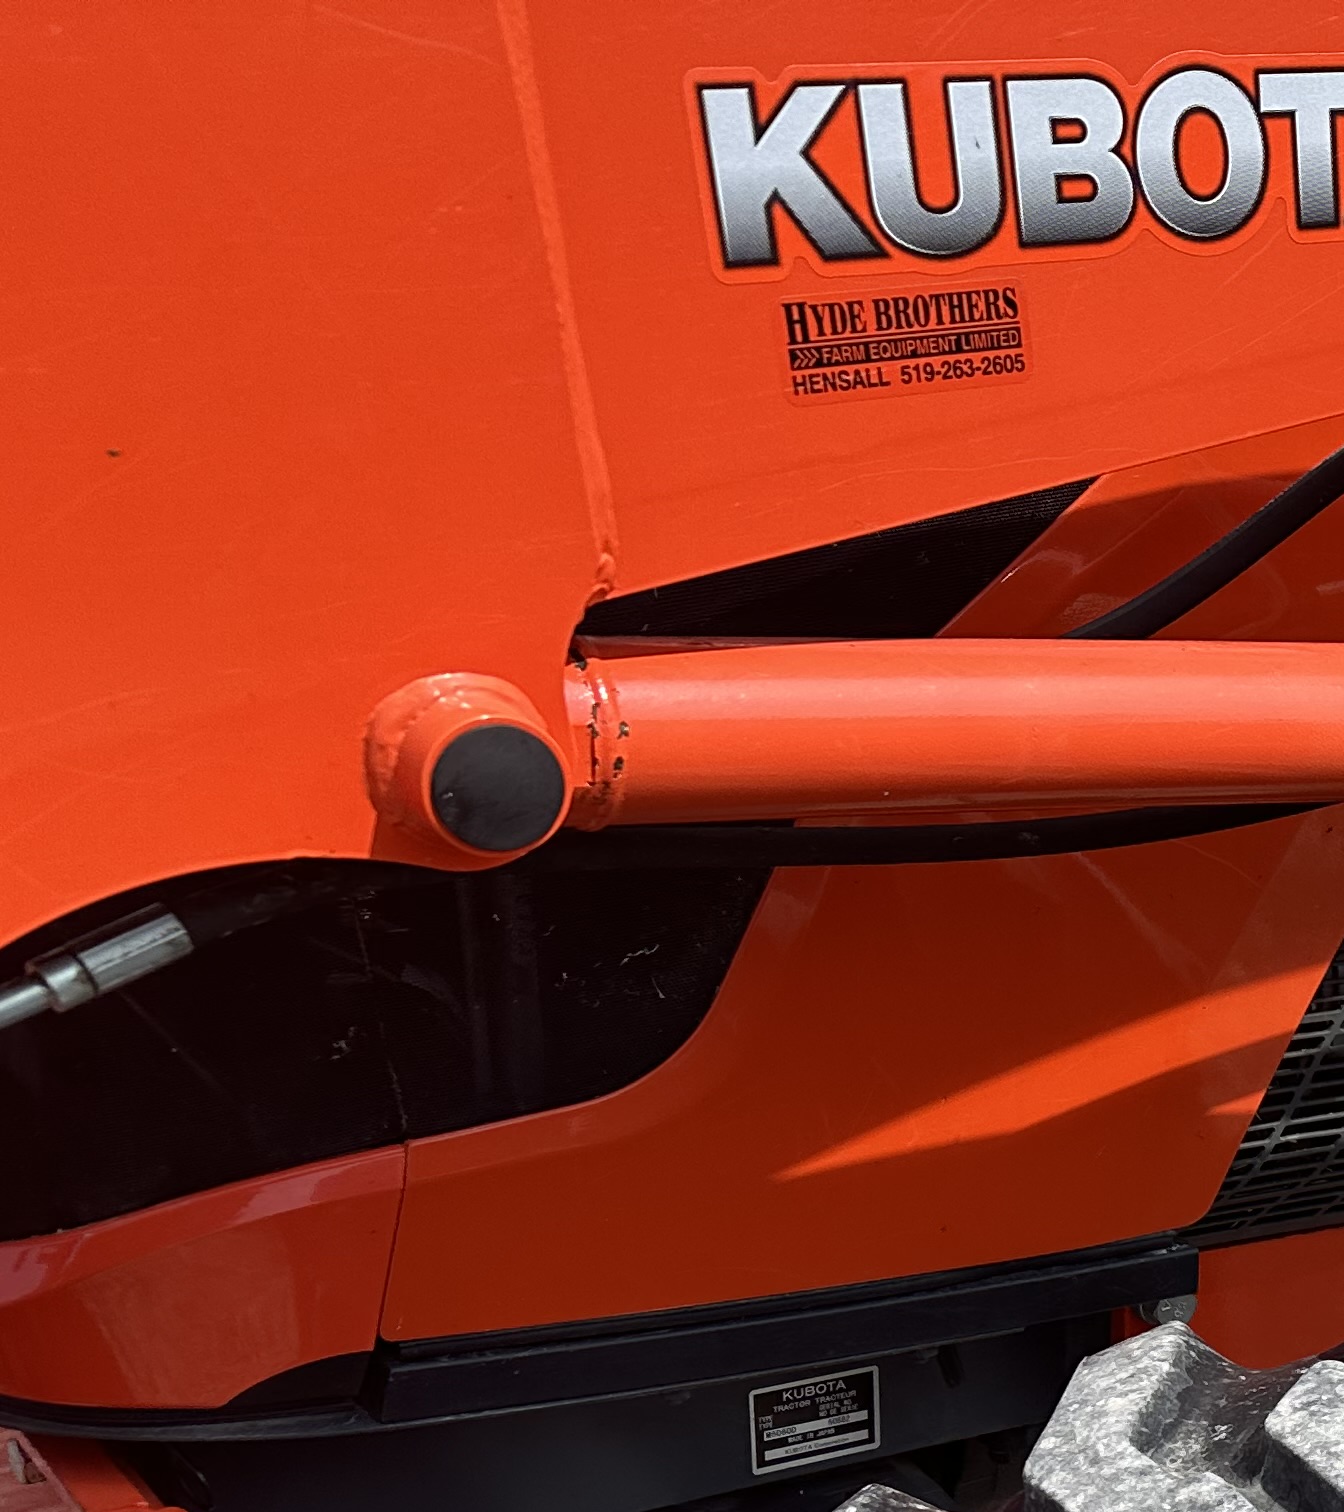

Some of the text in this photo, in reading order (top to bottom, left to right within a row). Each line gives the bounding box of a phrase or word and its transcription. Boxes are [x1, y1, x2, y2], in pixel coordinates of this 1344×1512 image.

[783, 286, 1020, 347] HYDE BROTHERS
[821, 328, 1020, 366] FARM EQUIPMENT LIMITED
[793, 353, 1025, 396] HENSALL 519-263-2605
[772, 1399, 810, 1413] TRACTOR
[782, 1379, 846, 1402] KUBOTA
